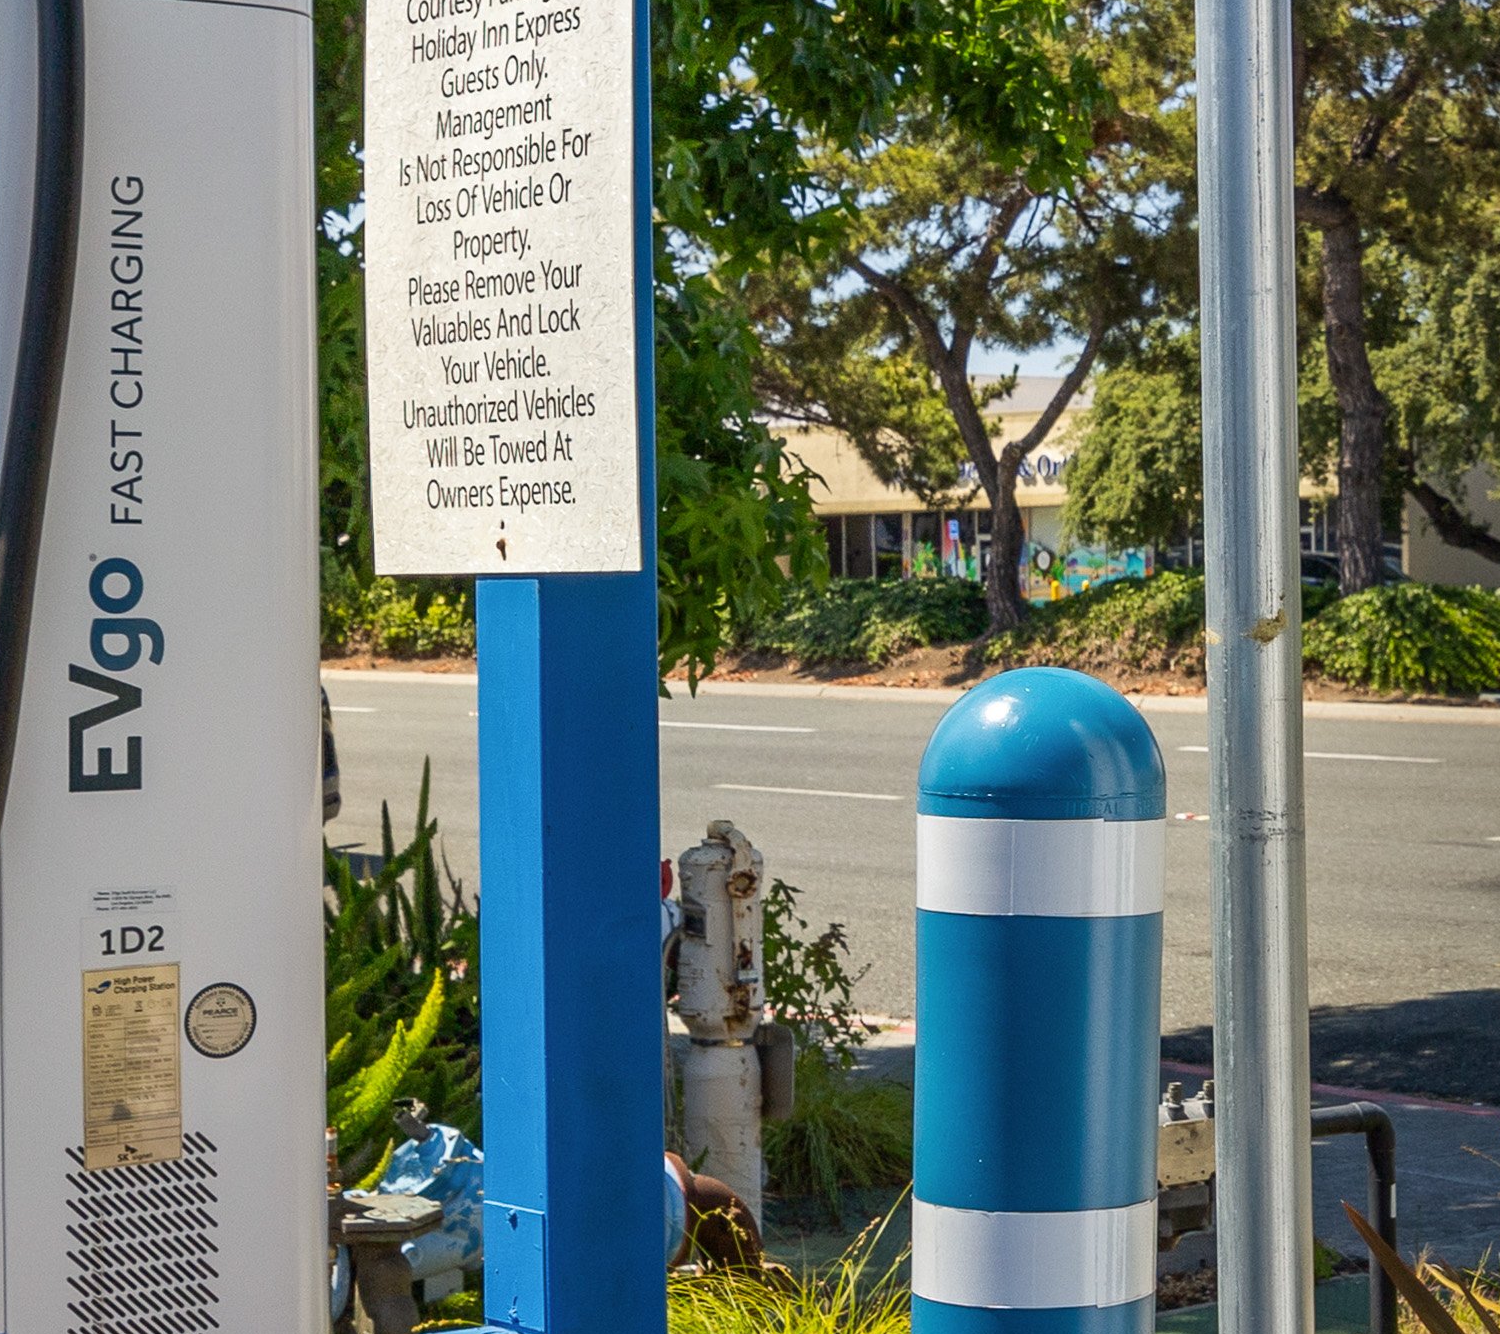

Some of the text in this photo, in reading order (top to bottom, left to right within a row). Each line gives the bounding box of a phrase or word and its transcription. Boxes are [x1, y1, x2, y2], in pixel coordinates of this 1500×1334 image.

[411, 6, 581, 63] Holiday Inn Express
[441, 50, 548, 98] Guests Only.
[436, 93, 552, 140] Management
[400, 128, 591, 187] Is Not Responsible For
[416, 173, 572, 224] Loss Of Vehicle Or
[453, 226, 531, 264] Property.
[408, 259, 582, 307] Please Remove Your
[411, 299, 580, 347] Valuables And Lock
[441, 346, 550, 384] Your Vehicle.
[403, 386, 595, 429] Unauthorized Vehicles
[426, 431, 572, 467] Will Be Towed At
[69, 175, 164, 793] EVgo FAST CHARGING
[426, 476, 576, 513] Owners Expense.
[100, 926, 164, 955] 1D2
[114, 977, 130, 985] High
[114, 985, 147, 994] Charging
[149, 983, 175, 991] Station
